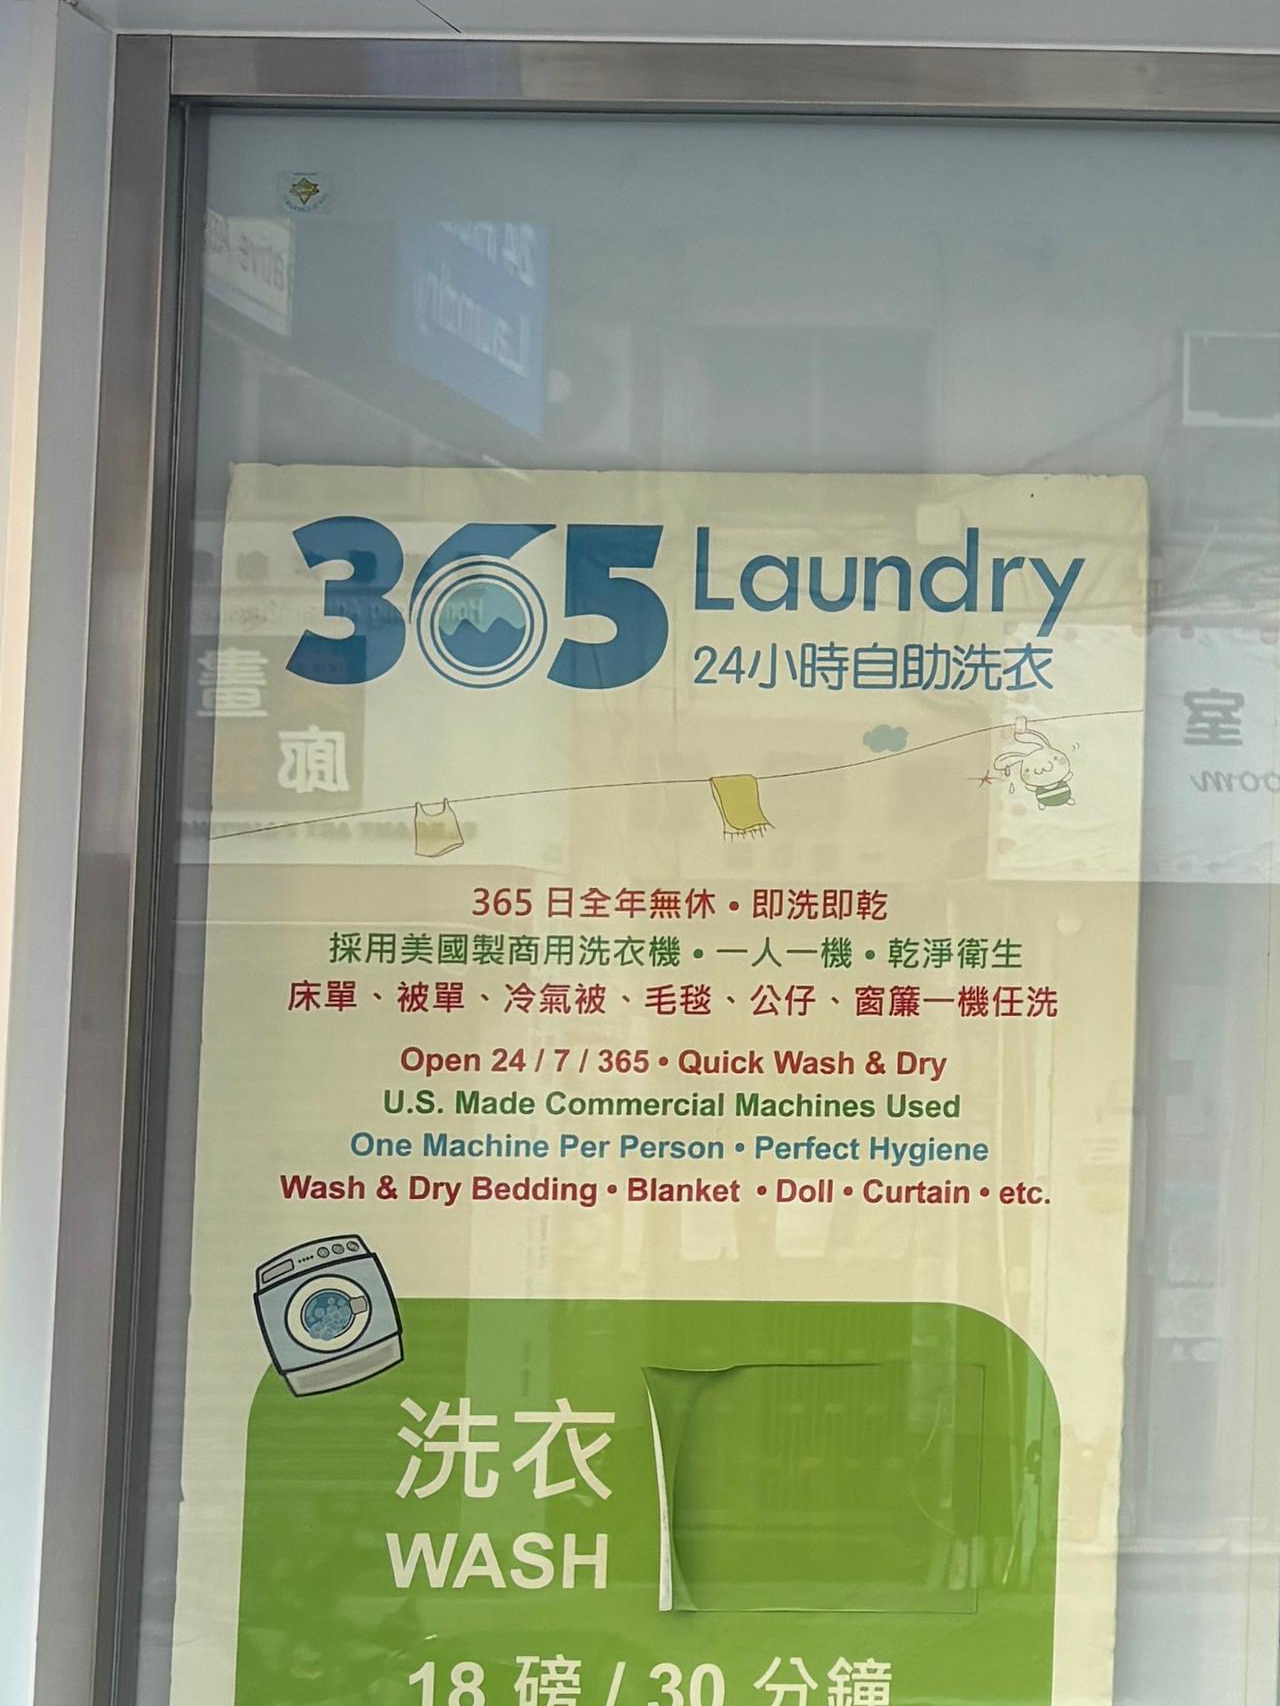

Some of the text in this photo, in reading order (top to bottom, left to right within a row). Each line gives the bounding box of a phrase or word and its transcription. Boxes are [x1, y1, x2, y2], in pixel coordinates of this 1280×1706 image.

[285, 514, 1087, 689] 365 Laundry
[692, 641, 1055, 693] 24小時自助洗衣
[472, 887, 888, 921] 365 日全年無休 即洗即乾
[329, 931, 1024, 970] 採用美國製商用洗衣機 一人一機 乾淨衛生
[400, 1047, 947, 1082] Open 24 7 365 Quick Wash & Dry
[383, 1091, 961, 1118] U.S. Made Commercial Machines Used
[350, 1132, 990, 1169] One Machine Per Person Perfect Hygiene
[280, 1174, 1052, 1209] Wash & Dry Bedding Blanket Doll Curtain etc.
[394, 1396, 617, 1502] 洗衣
[386, 1531, 609, 1591] WASH
